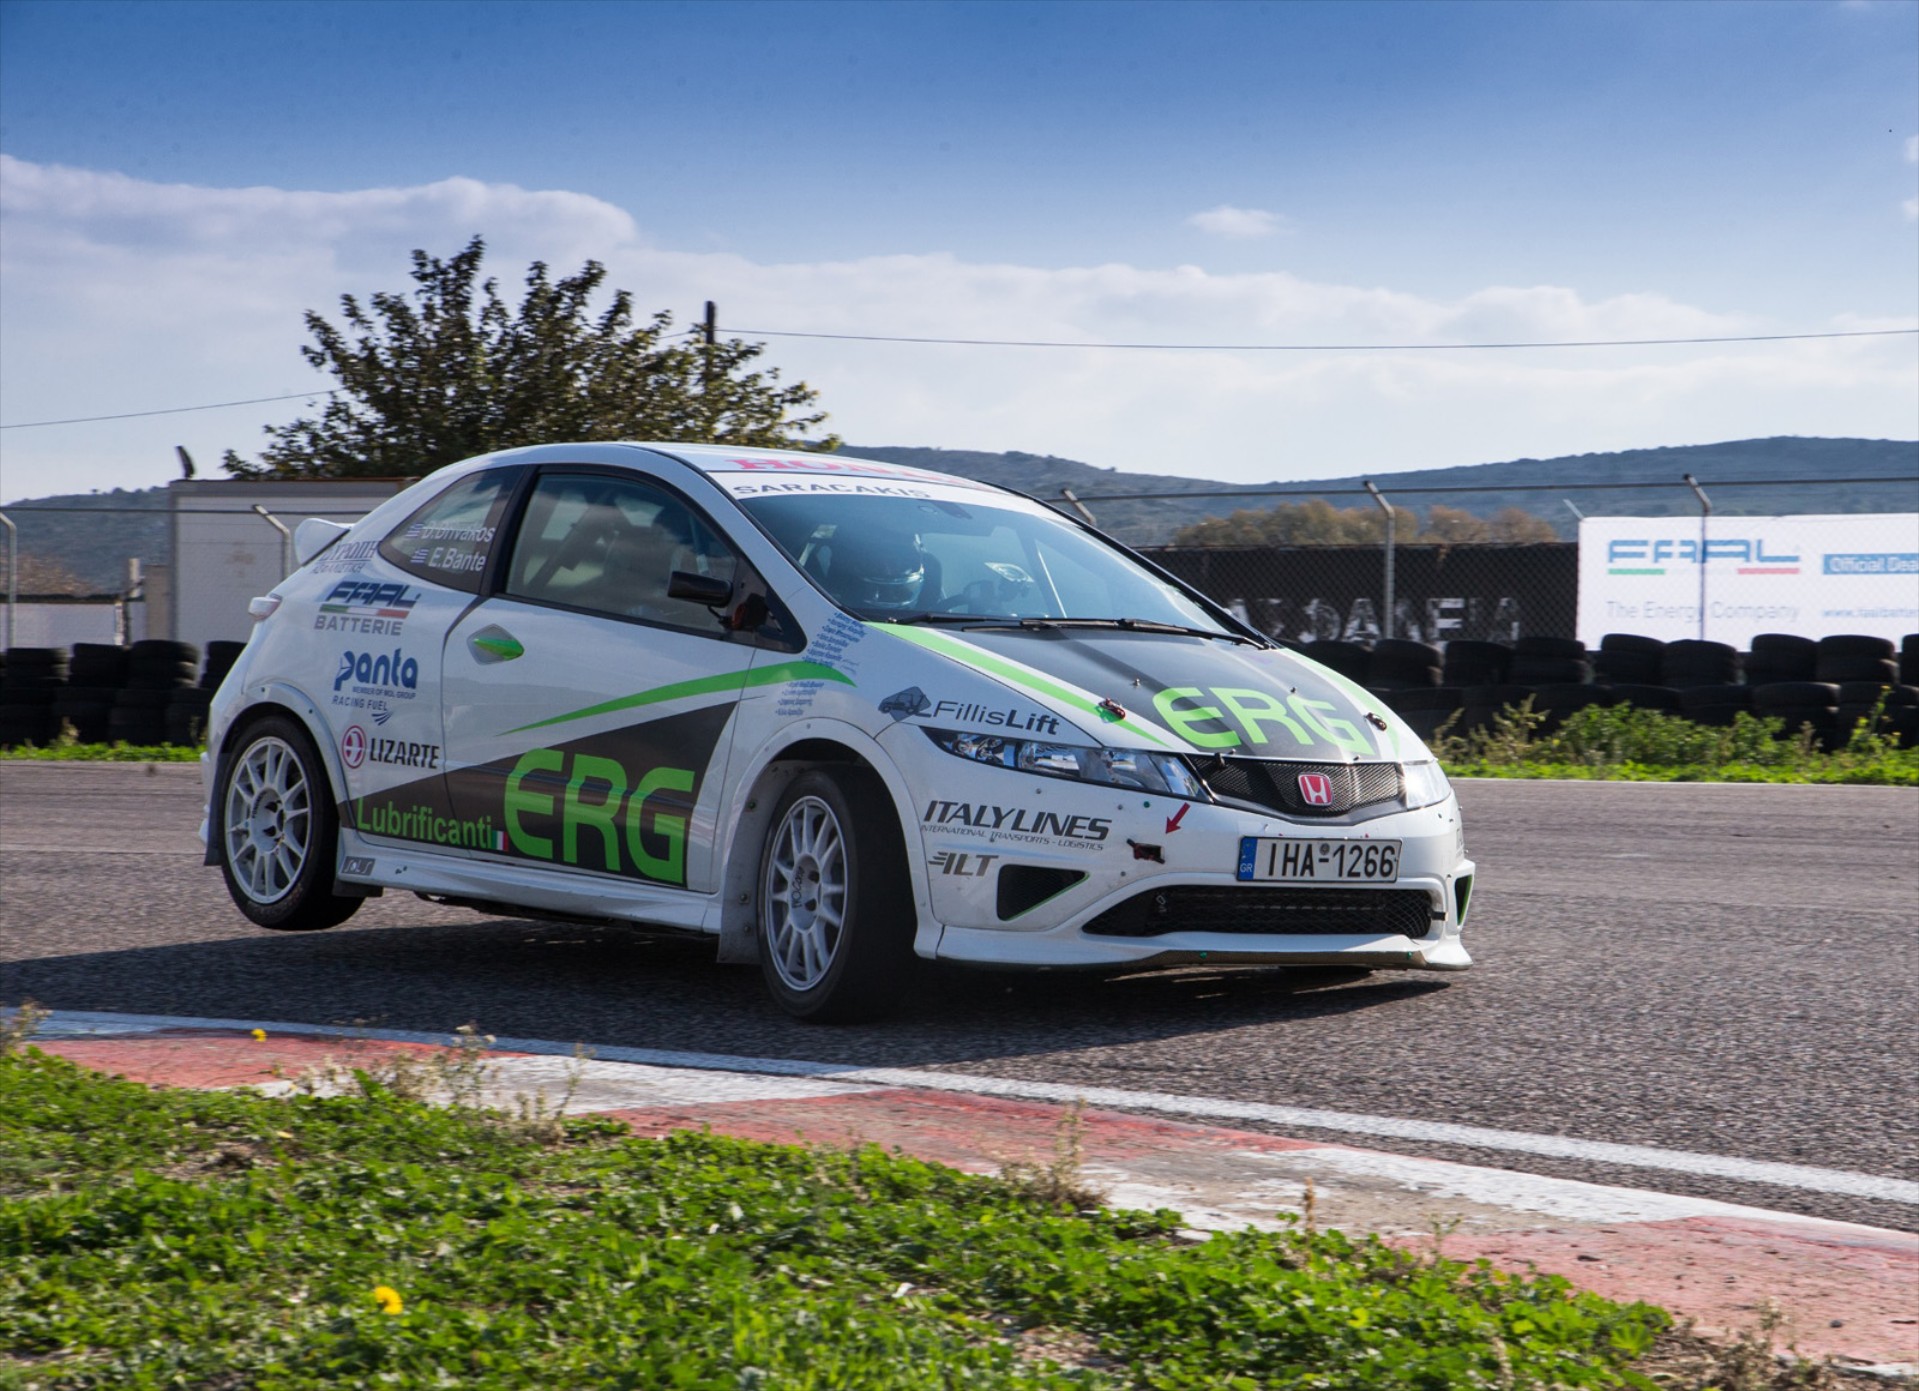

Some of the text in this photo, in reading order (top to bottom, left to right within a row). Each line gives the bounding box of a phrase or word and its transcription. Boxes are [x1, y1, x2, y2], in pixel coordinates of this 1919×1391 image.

[734, 483, 932, 498] SARACAKIS
[428, 546, 487, 572] E.Bante
[1606, 601, 1799, 623] The Energy Company
[313, 615, 405, 636] BATTERIE
[332, 695, 389, 711] RACING FUEL
[375, 688, 384, 696] OF
[396, 691, 416, 700] GROUP
[932, 700, 1060, 735] FillisLift
[1152, 687, 1375, 755] ERG
[369, 738, 440, 769] LIZARTE
[356, 796, 492, 849] Lubrificanti
[504, 748, 695, 884] ERG
[923, 800, 1112, 841] ITALYLINES
[920, 825, 986, 838] INTERNATIONAL
[990, 831, 1049, 845] TRANSPORTS
[1058, 840, 1104, 851] LOGISTICS
[1240, 863, 1253, 873] GR
